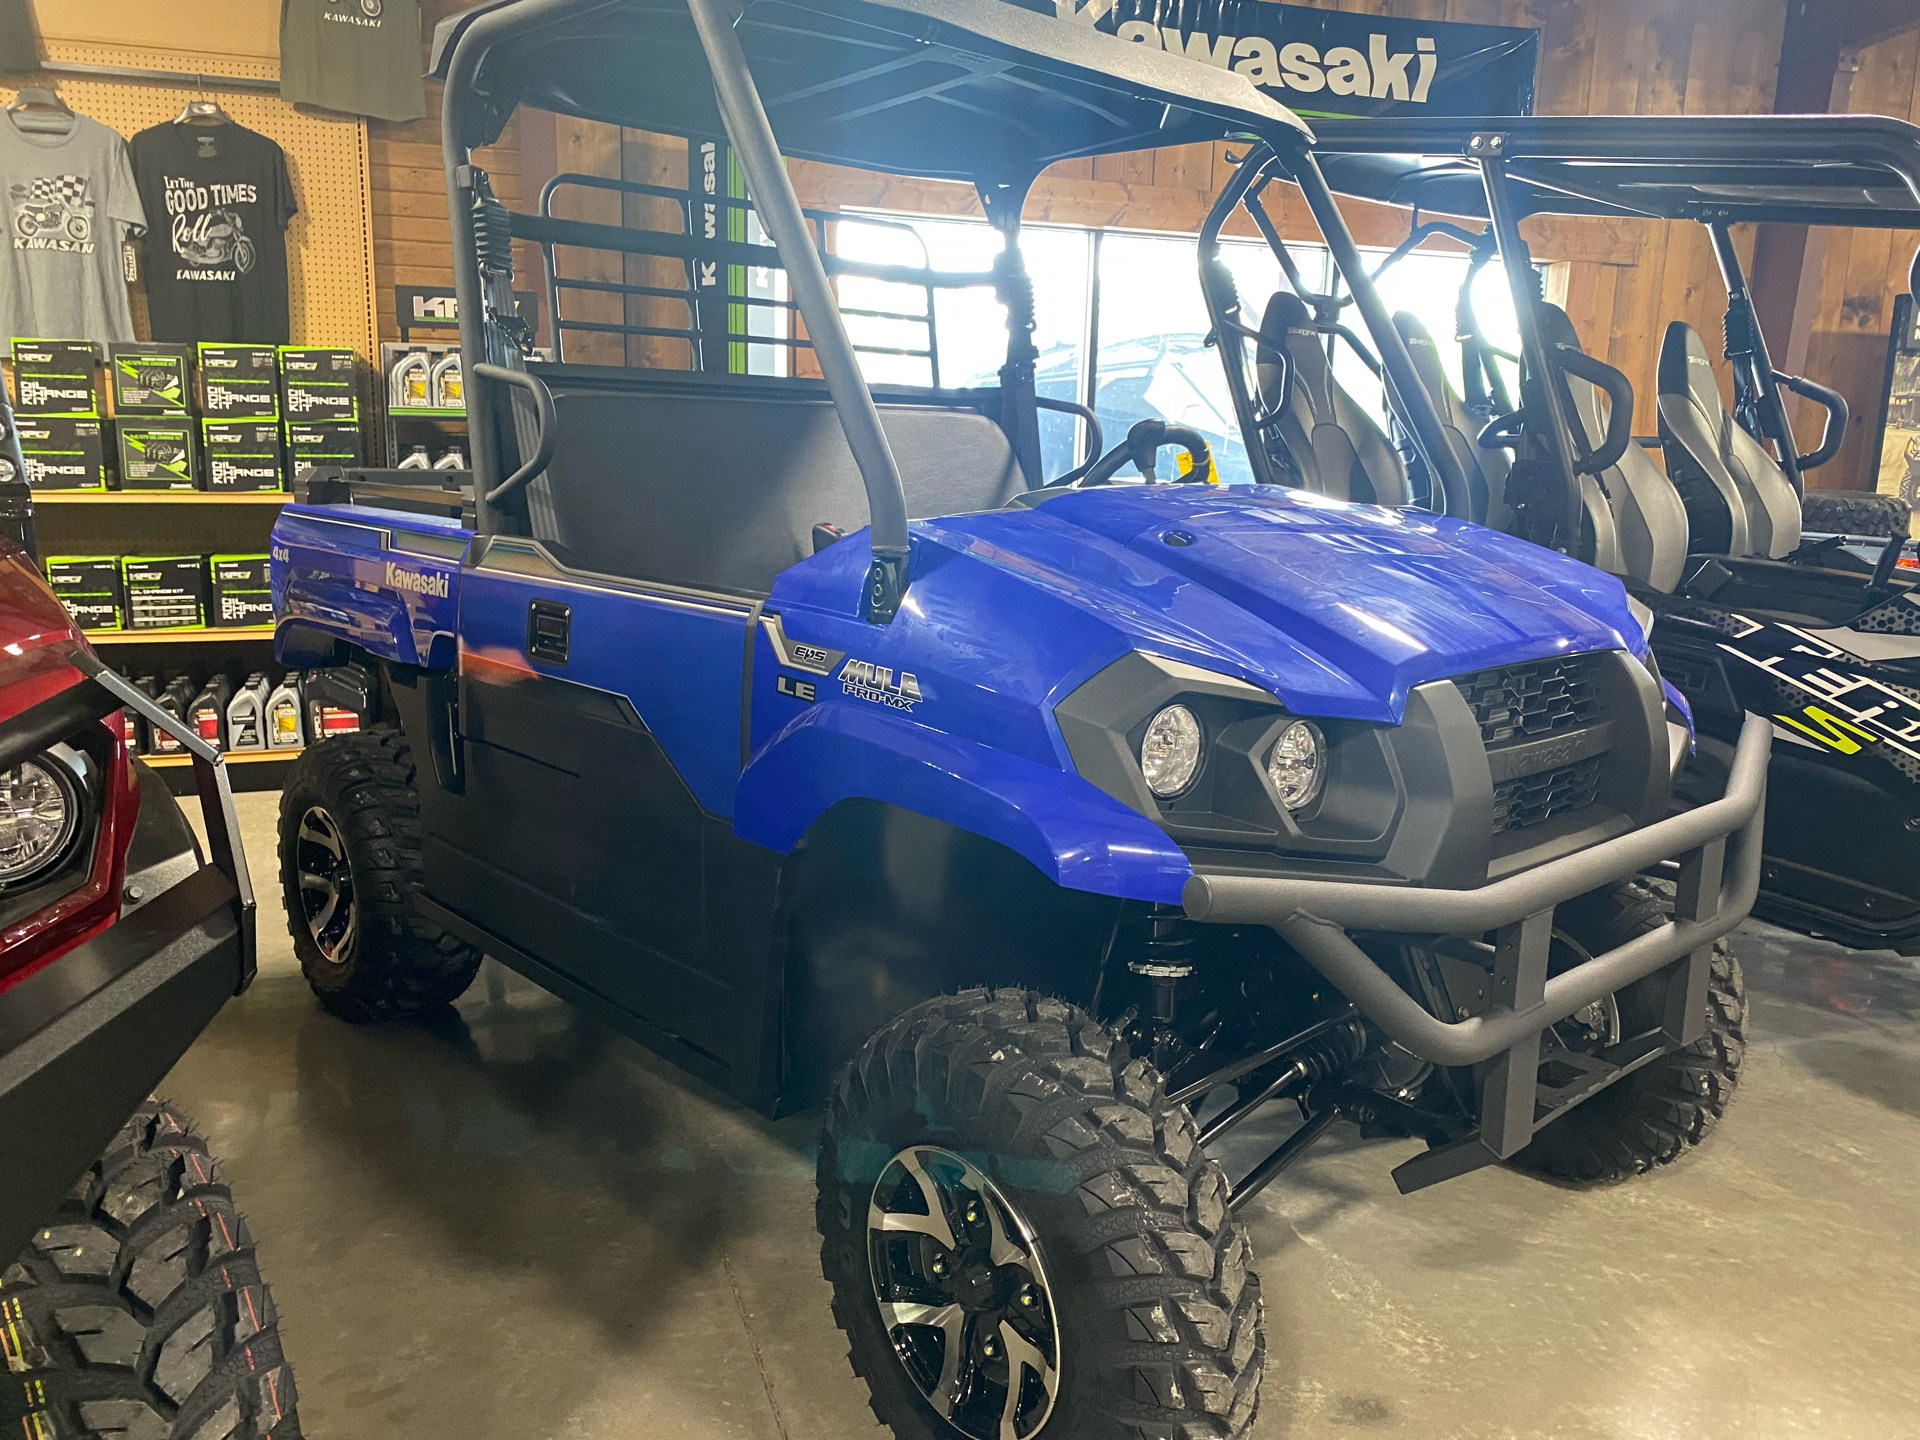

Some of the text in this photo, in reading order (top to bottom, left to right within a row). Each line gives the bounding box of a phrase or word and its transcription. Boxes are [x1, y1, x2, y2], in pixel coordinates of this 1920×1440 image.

[324, 12, 381, 27] KAWASAKI
[165, 184, 257, 215] GOOD TIMES
[172, 213, 212, 253] Roll
[176, 269, 236, 281] KAWASAKI
[20, 381, 47, 390] OIL
[21, 389, 88, 399] CHANGE
[207, 386, 232, 395] OIL
[287, 389, 312, 397] OIL
[22, 397, 47, 406] KIT
[207, 394, 271, 403] CHANGE
[288, 397, 350, 406] CHANGE
[208, 402, 232, 410] KIT
[289, 404, 312, 412] KIT
[211, 461, 236, 470] OIL
[212, 469, 275, 477] CHANGE
[212, 476, 237, 485] KIT
[272, 546, 289, 563] 4x4
[385, 561, 449, 599] Kawasaki
[65, 605, 113, 614] HANGE
[222, 604, 273, 612] CHANG
[223, 611, 246, 619] KIT
[837, 658, 923, 702] MULE
[777, 676, 815, 701] LE
[843, 682, 914, 713] PRO-MX
